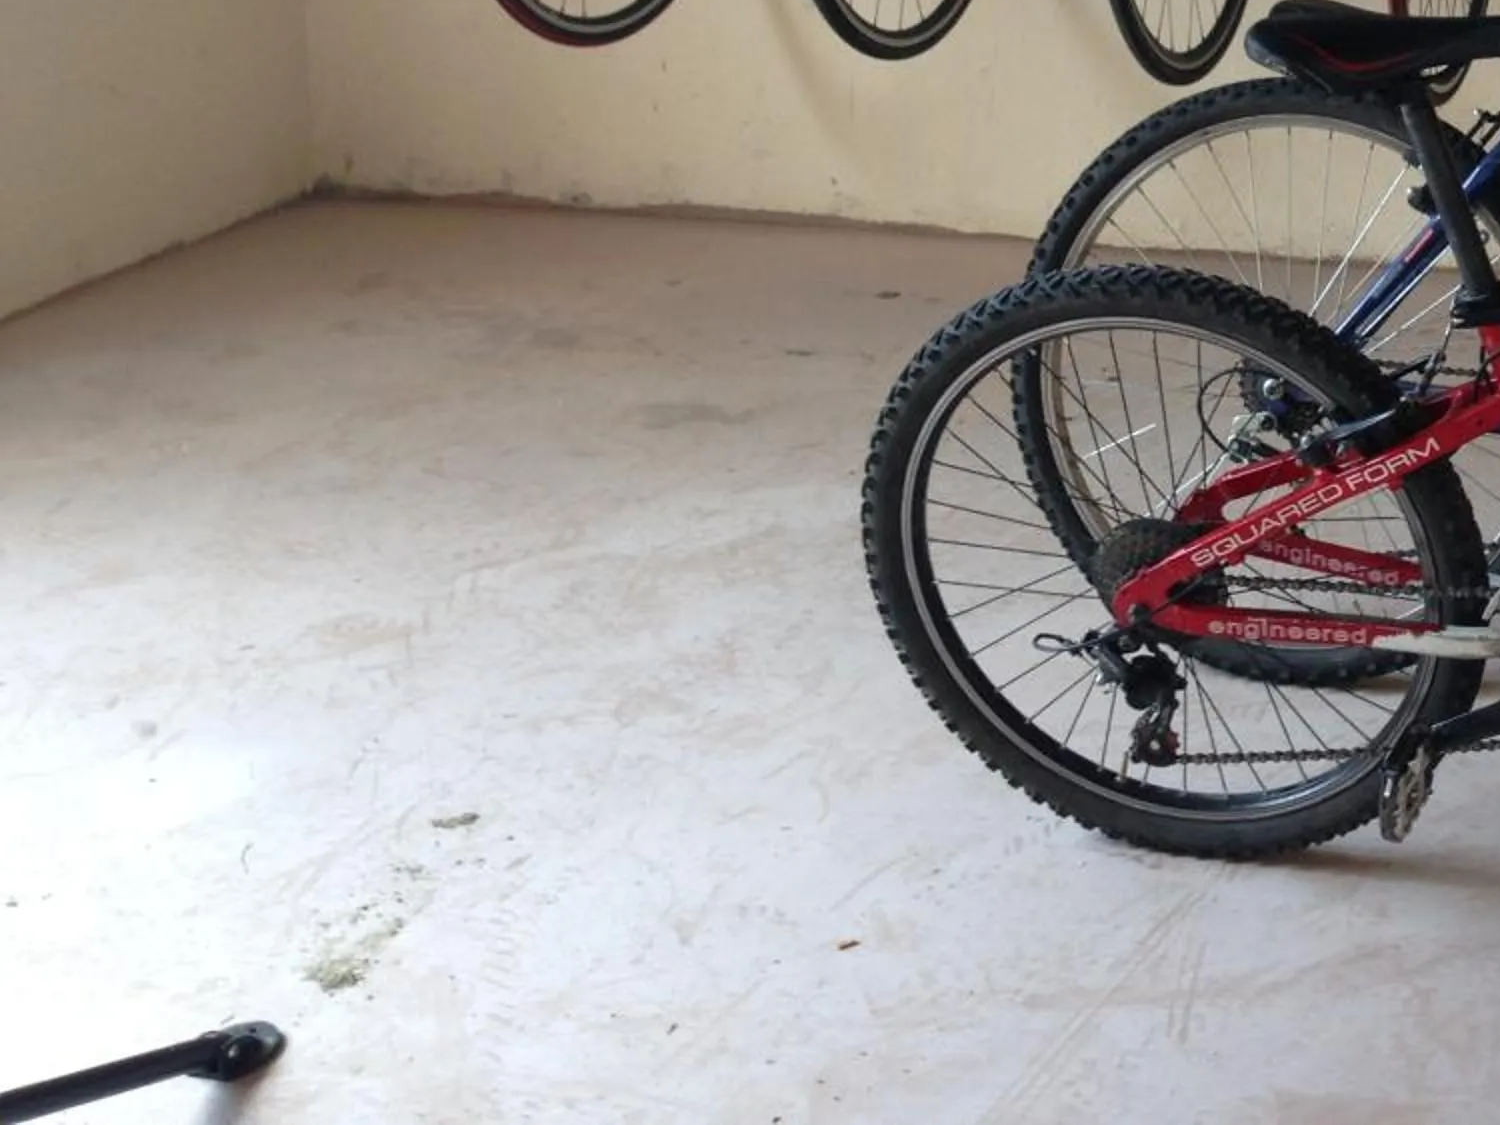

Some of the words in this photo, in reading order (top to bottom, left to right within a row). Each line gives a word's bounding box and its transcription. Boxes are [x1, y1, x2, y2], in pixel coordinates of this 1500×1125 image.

[1189, 481, 1344, 568] SQUARED
[1345, 436, 1441, 497] FORM
[1207, 616, 1368, 645] engineered
